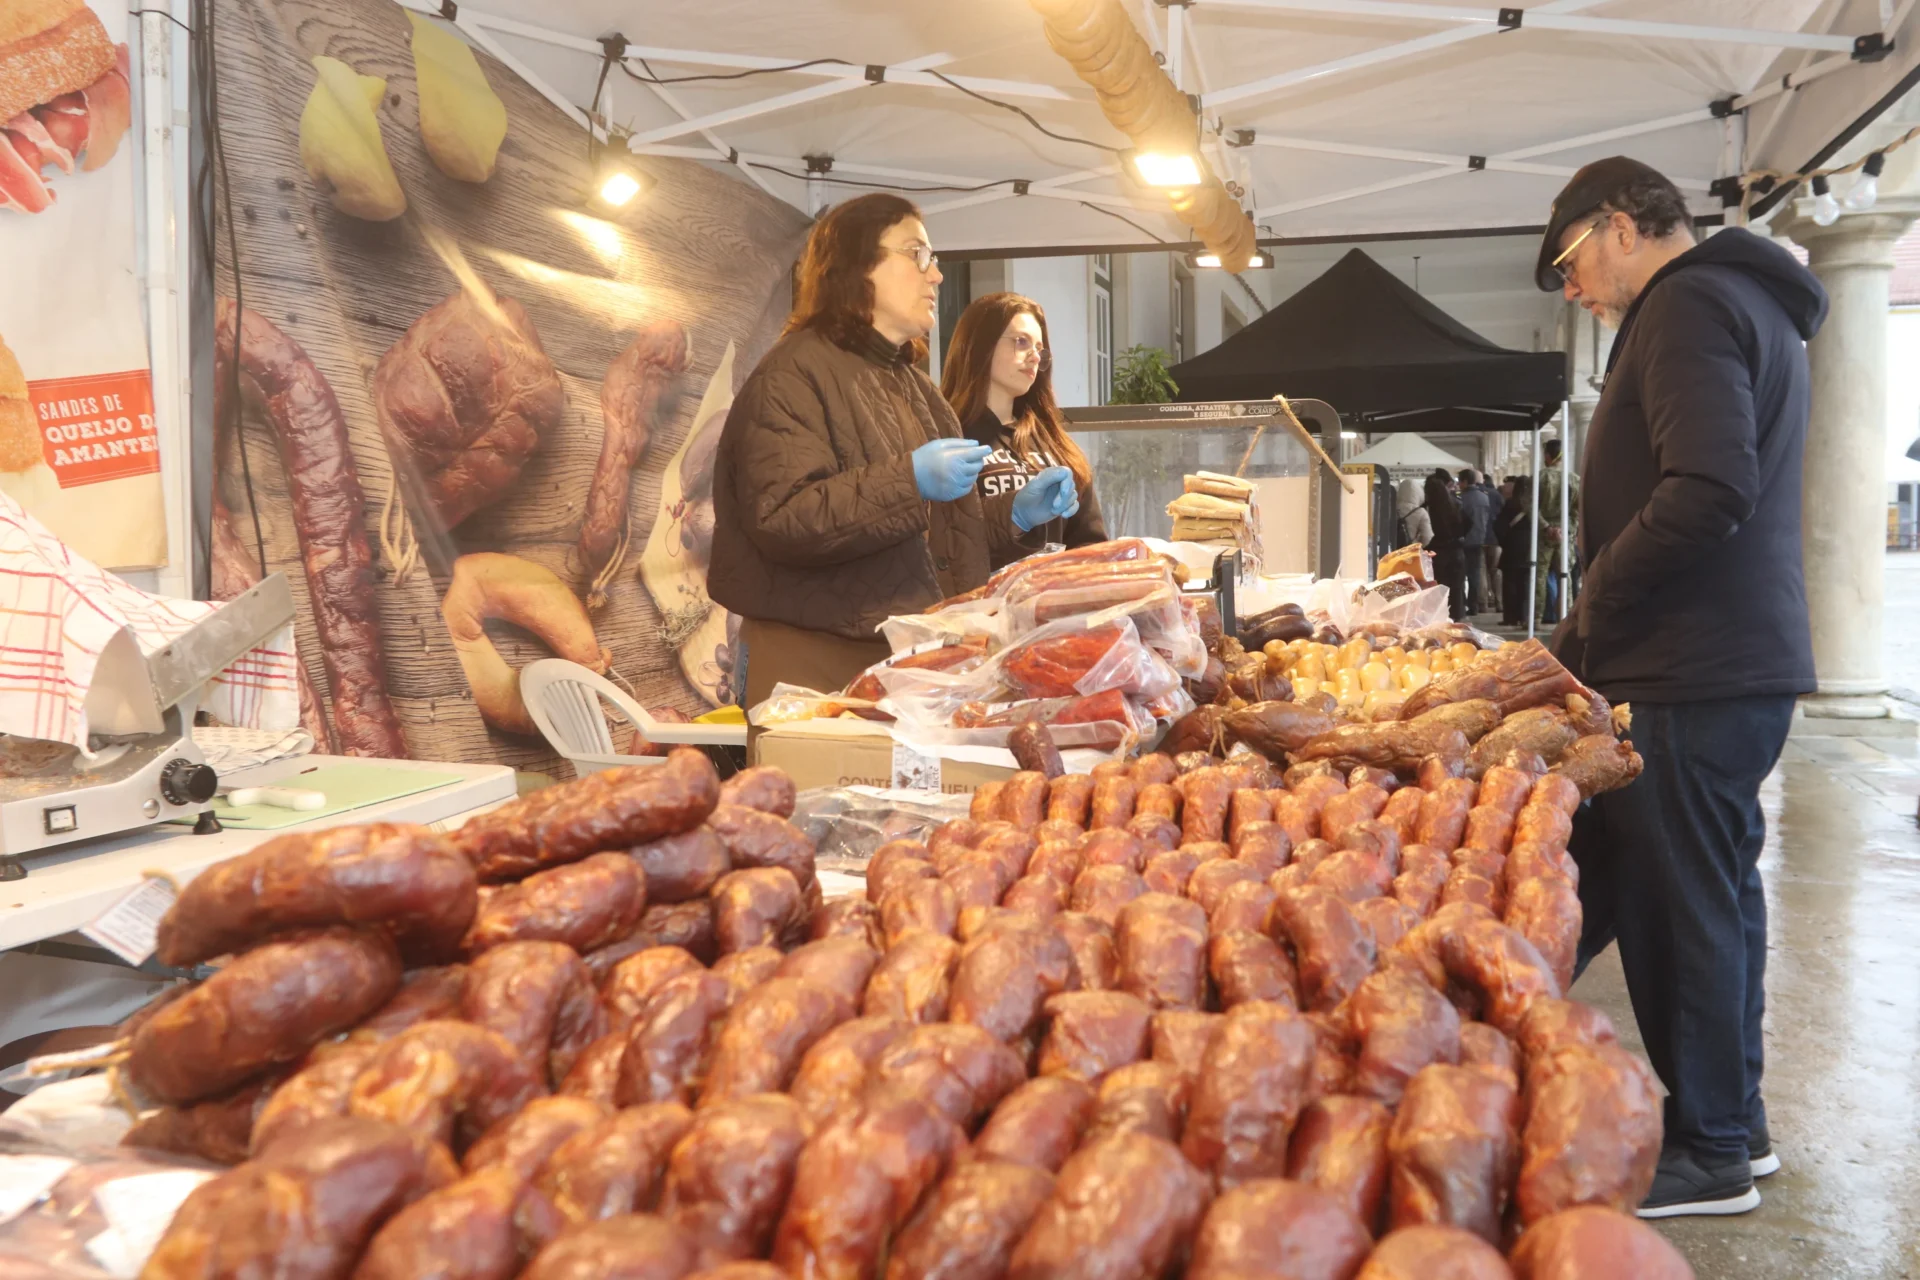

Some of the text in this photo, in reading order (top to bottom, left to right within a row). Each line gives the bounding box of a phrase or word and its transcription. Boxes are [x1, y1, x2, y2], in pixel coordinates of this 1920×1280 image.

[38, 394, 124, 421] SANDES DE
[1160, 404, 1231, 413] COIMBRA, ATRATIVA
[45, 417, 133, 444] QUEIJO
